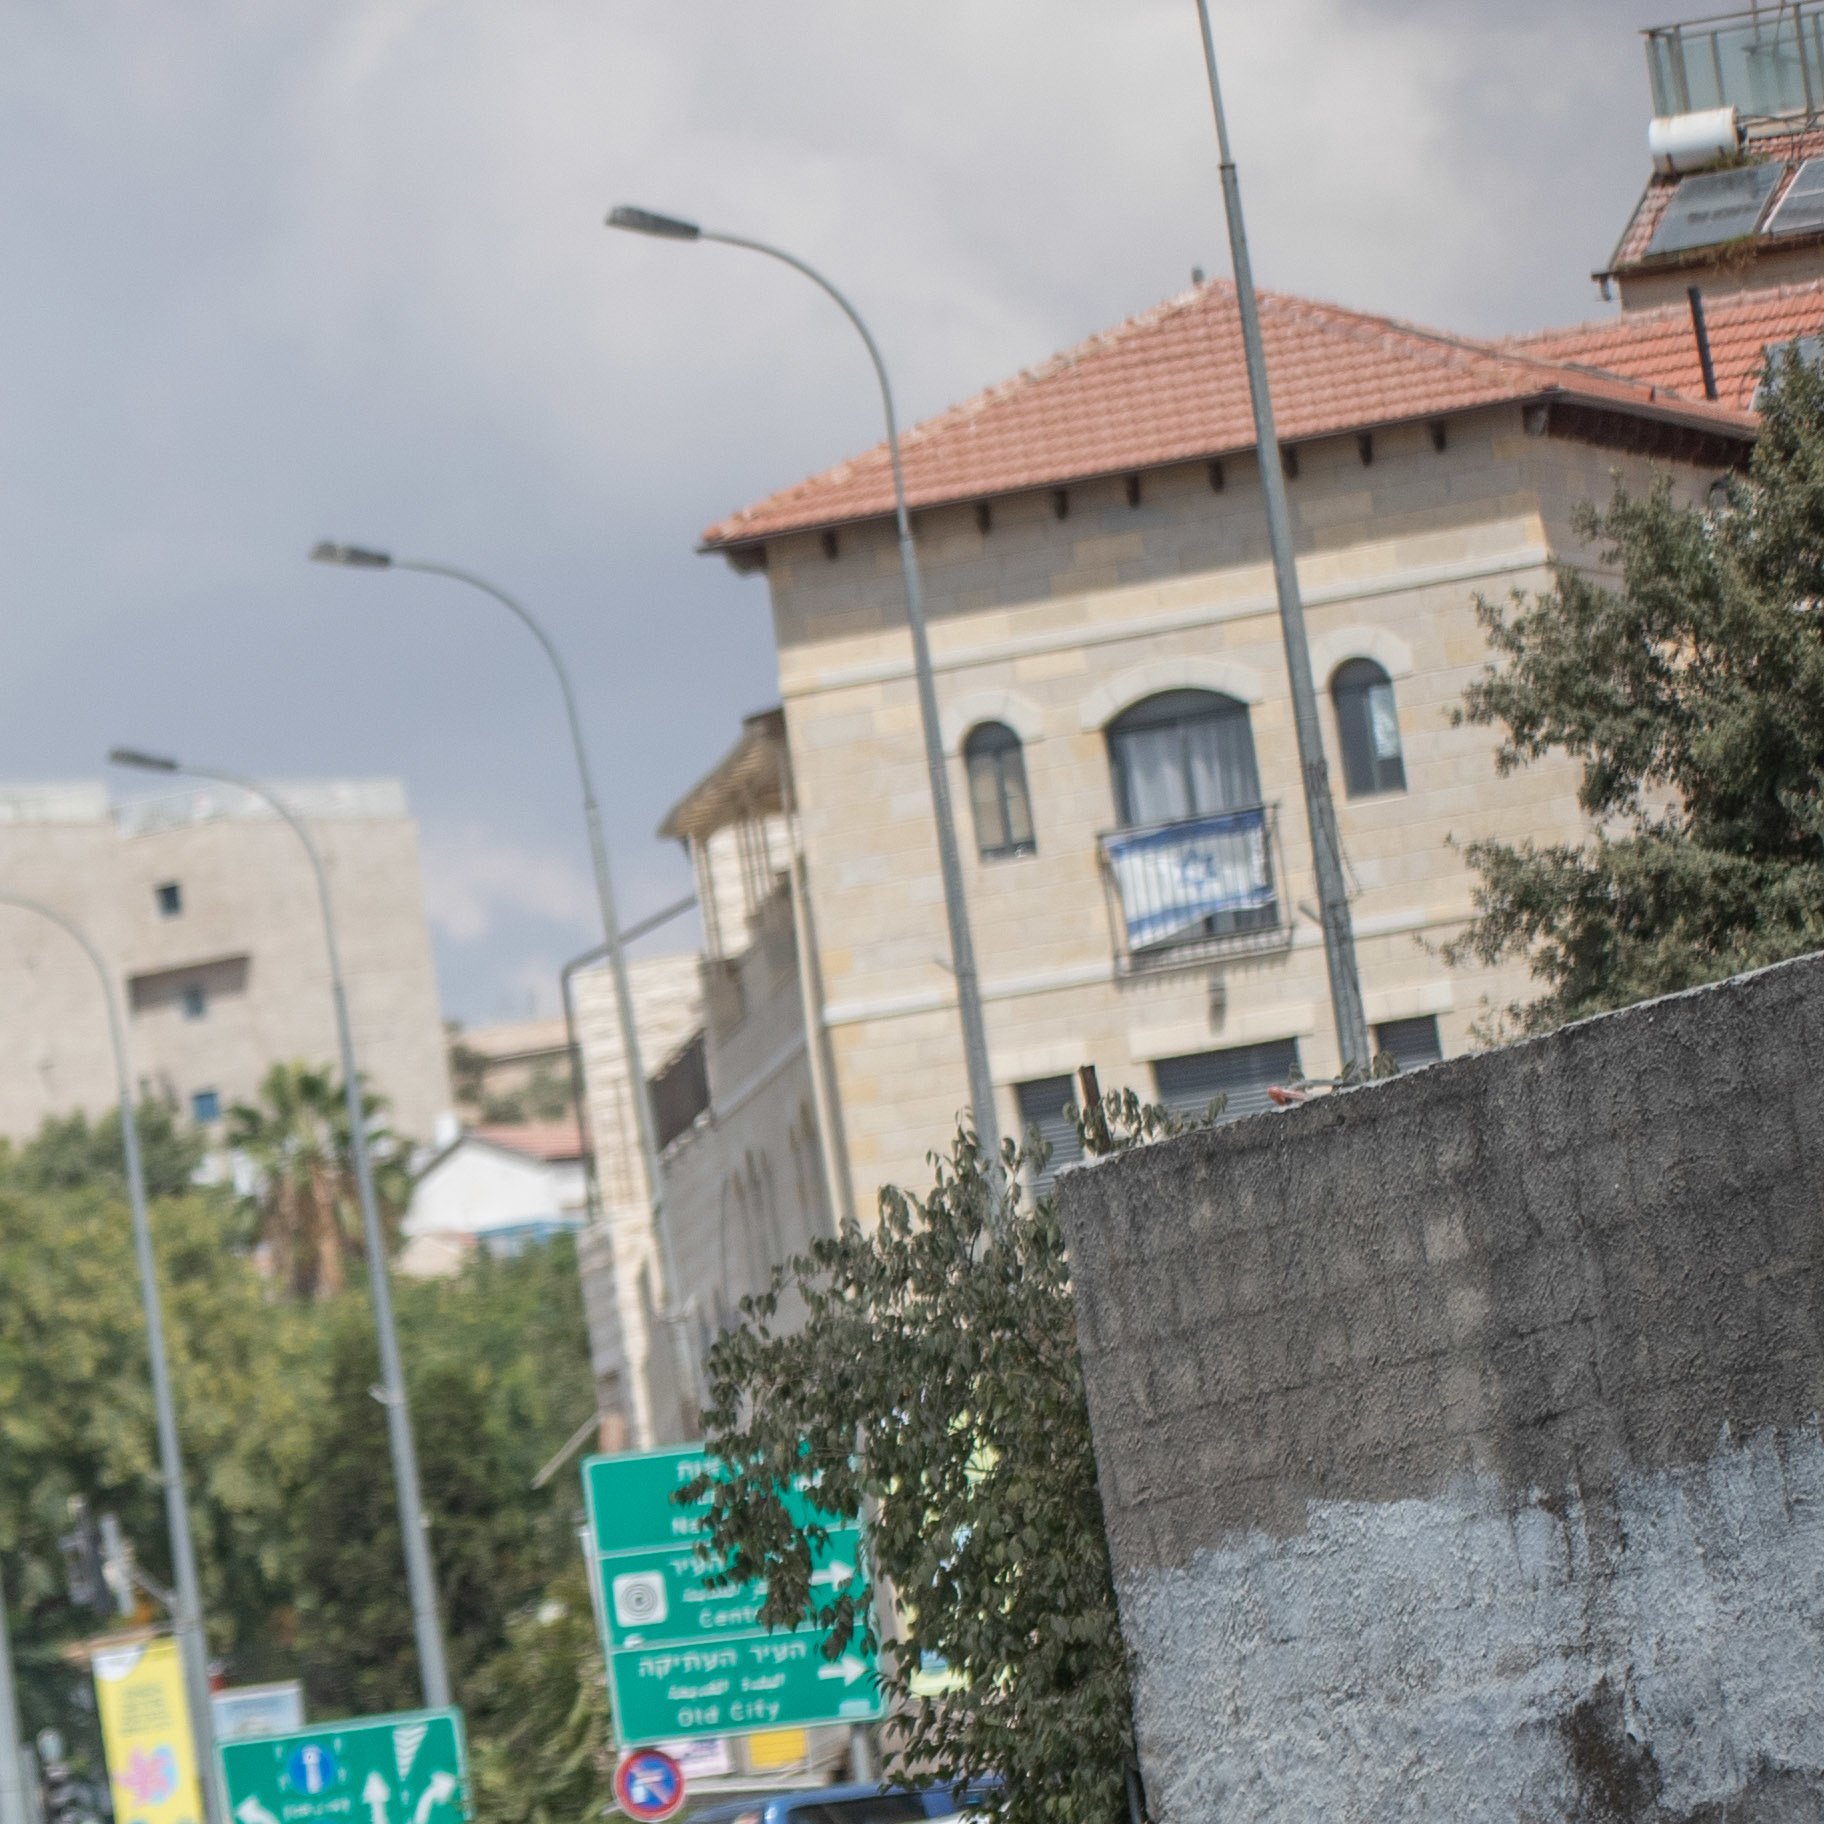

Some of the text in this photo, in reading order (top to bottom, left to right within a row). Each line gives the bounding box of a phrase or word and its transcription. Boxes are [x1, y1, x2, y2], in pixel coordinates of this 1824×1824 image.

[638, 1642, 806, 1680] העיר העתיקה
[677, 1698, 779, 1727] Old City
